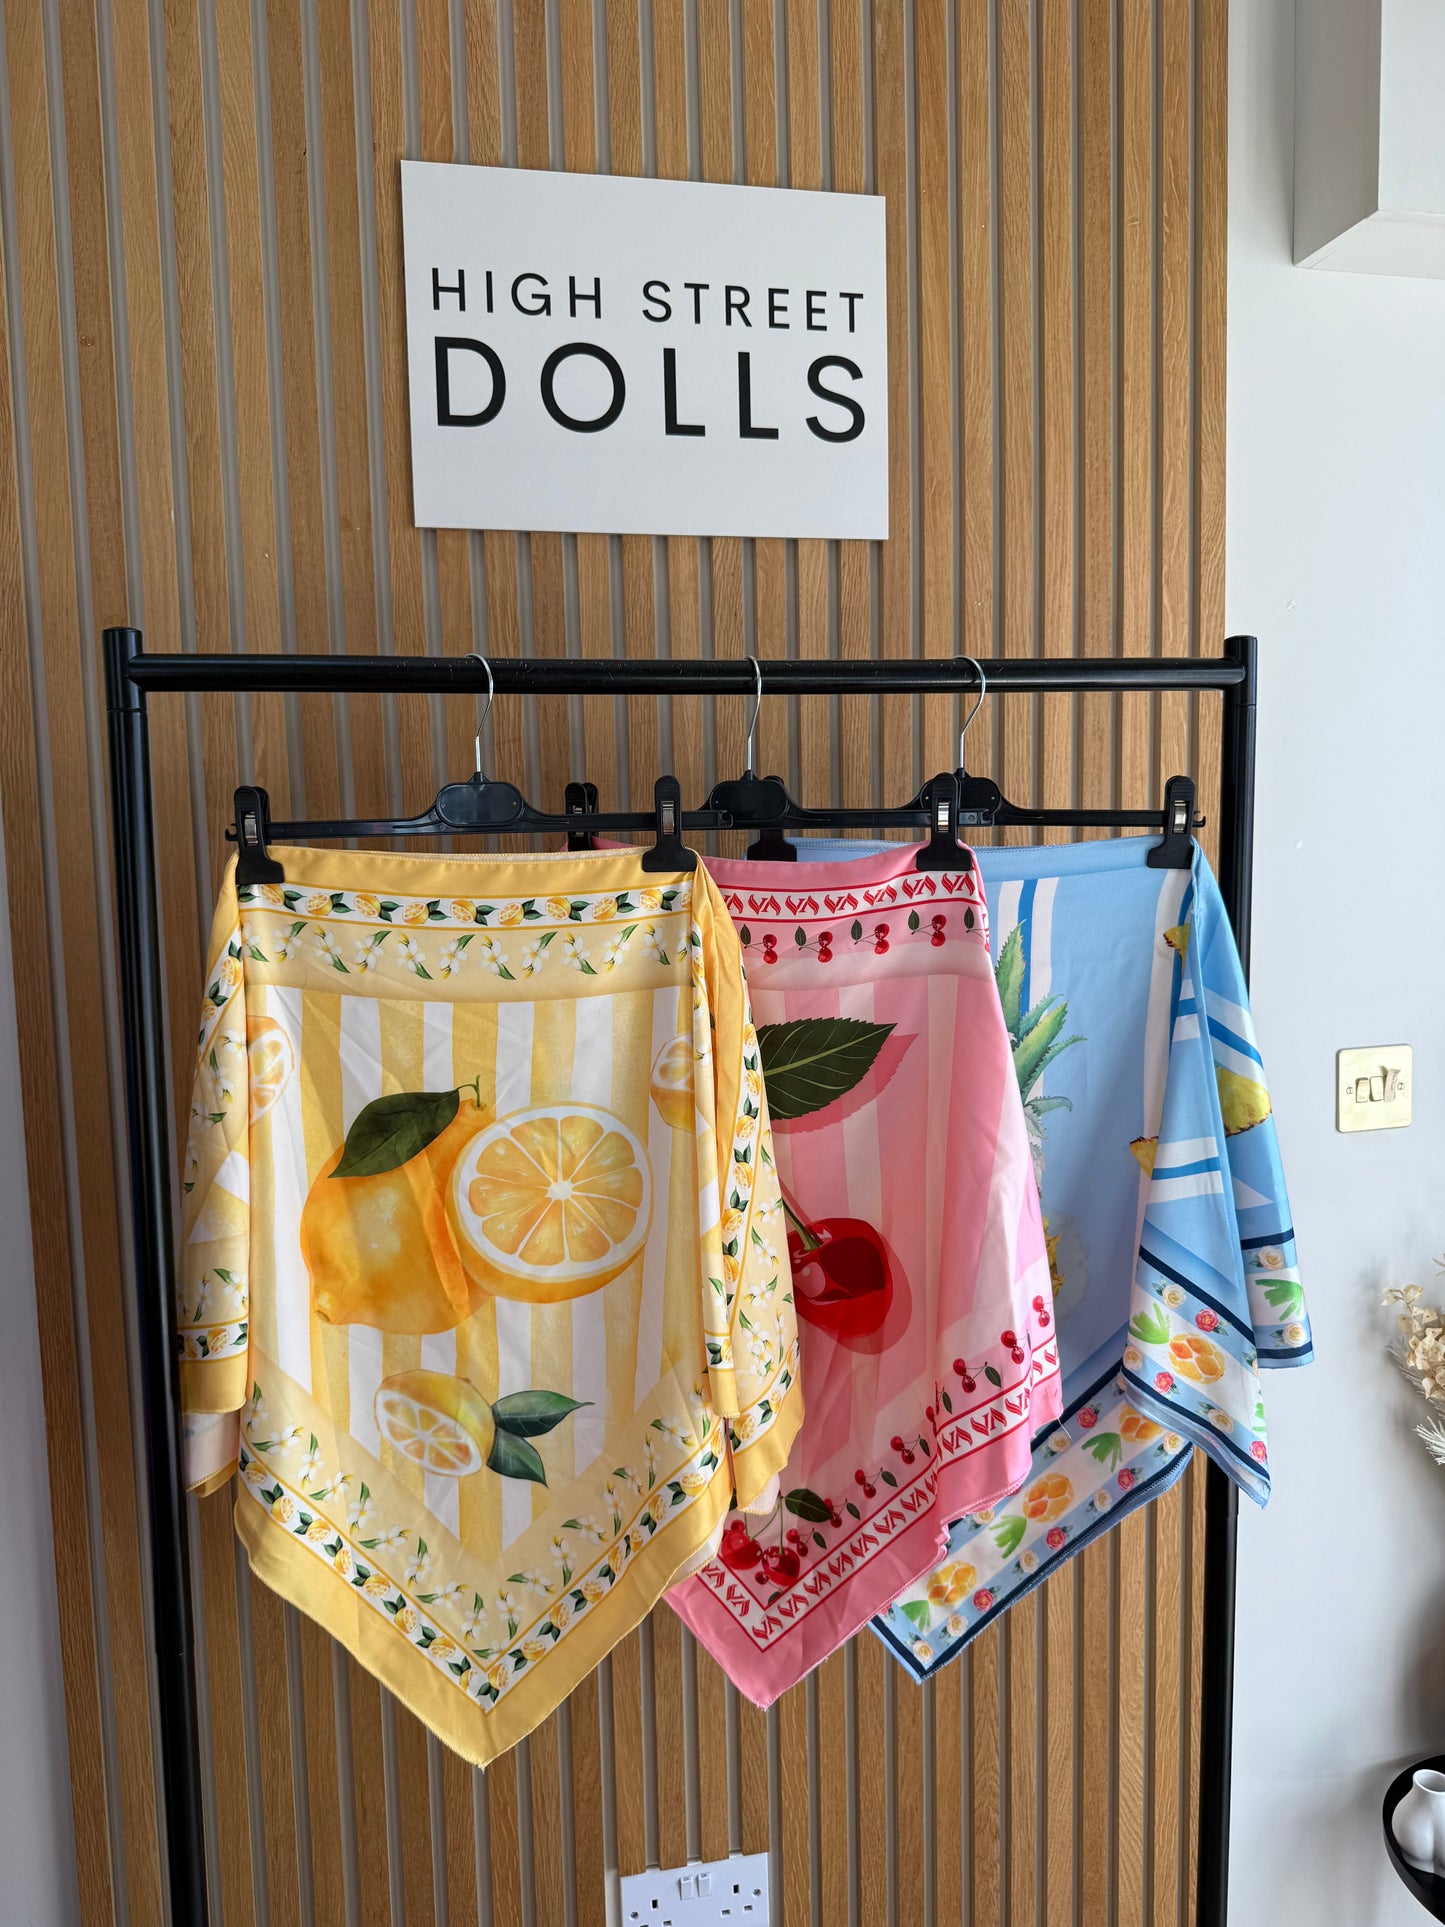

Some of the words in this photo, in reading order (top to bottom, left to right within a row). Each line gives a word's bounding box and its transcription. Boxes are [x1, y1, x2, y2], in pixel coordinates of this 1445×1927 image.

[431, 267, 602, 319] HIGH
[642, 280, 864, 333] STREET
[434, 335, 866, 444] DOLLS
